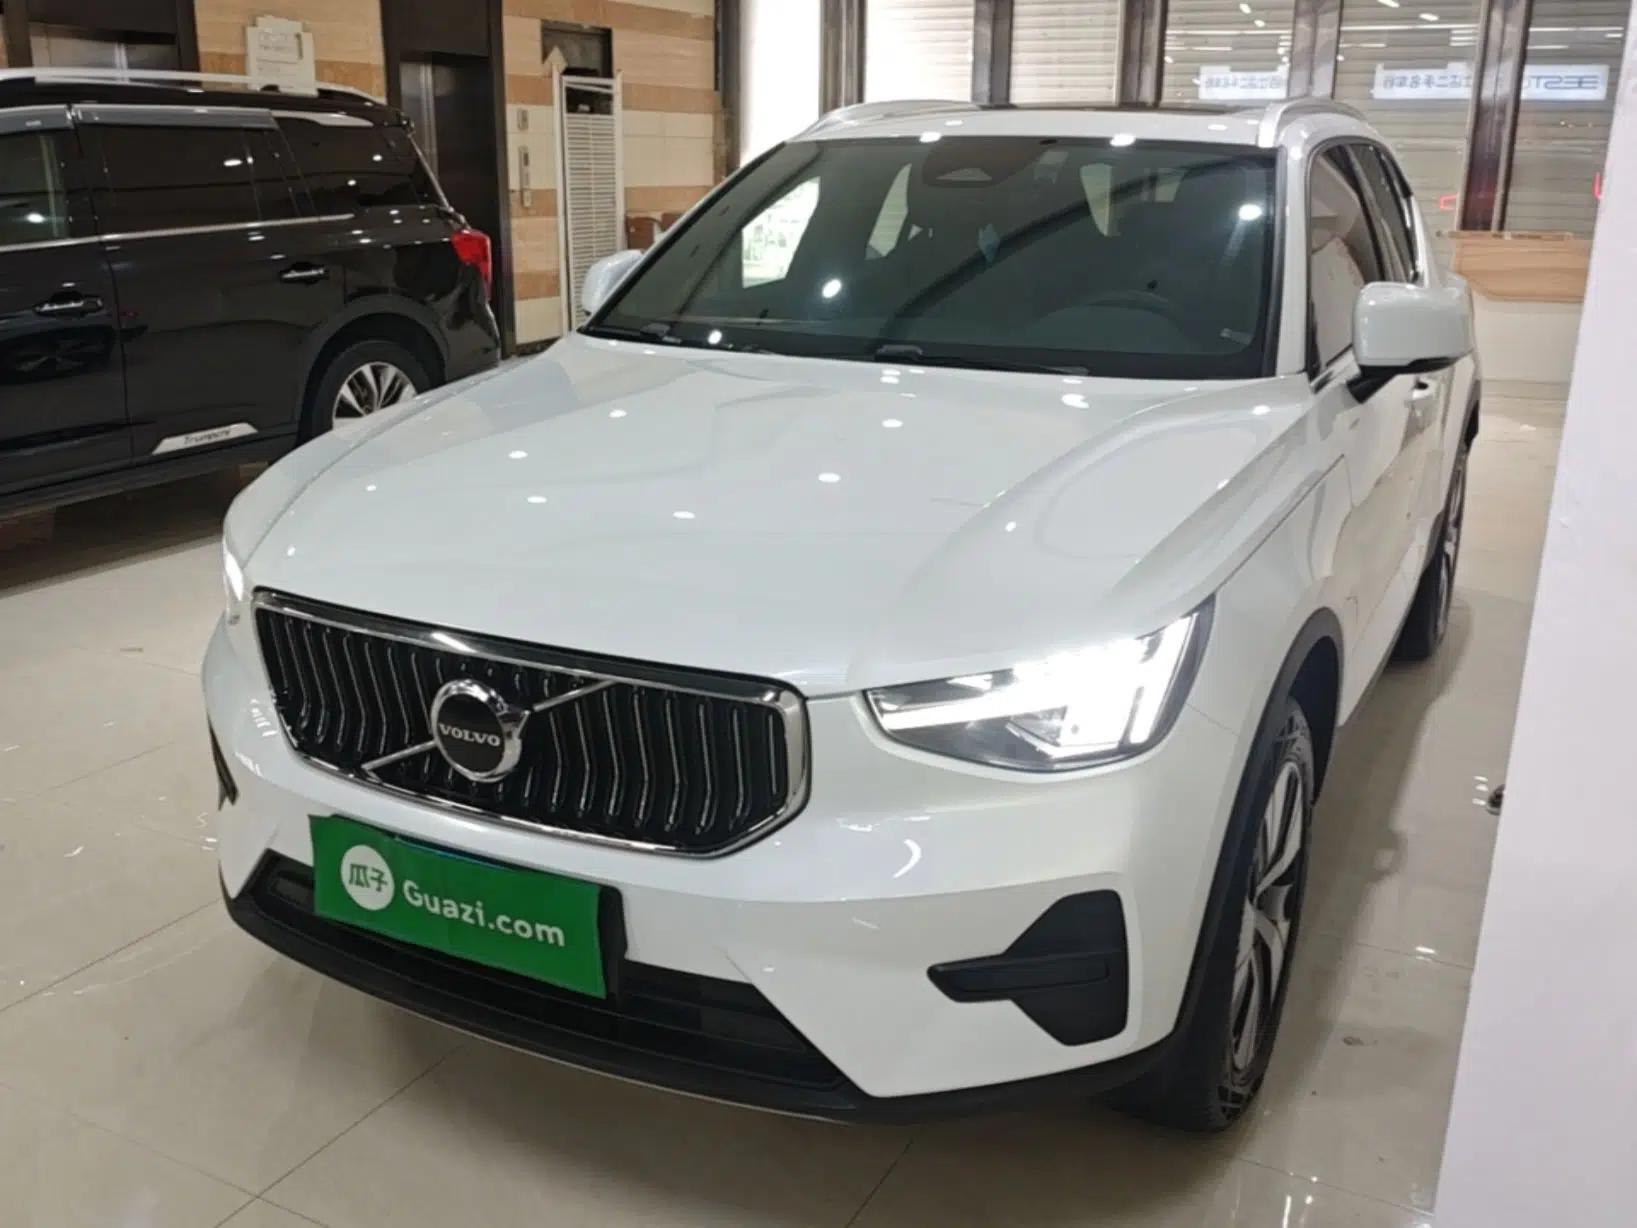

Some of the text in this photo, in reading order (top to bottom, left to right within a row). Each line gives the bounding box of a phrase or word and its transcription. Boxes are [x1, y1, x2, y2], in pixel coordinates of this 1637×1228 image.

[438, 722, 501, 747] VOLVO
[349, 863, 388, 893] 瓜子
[402, 879, 566, 948] Guazi.com
